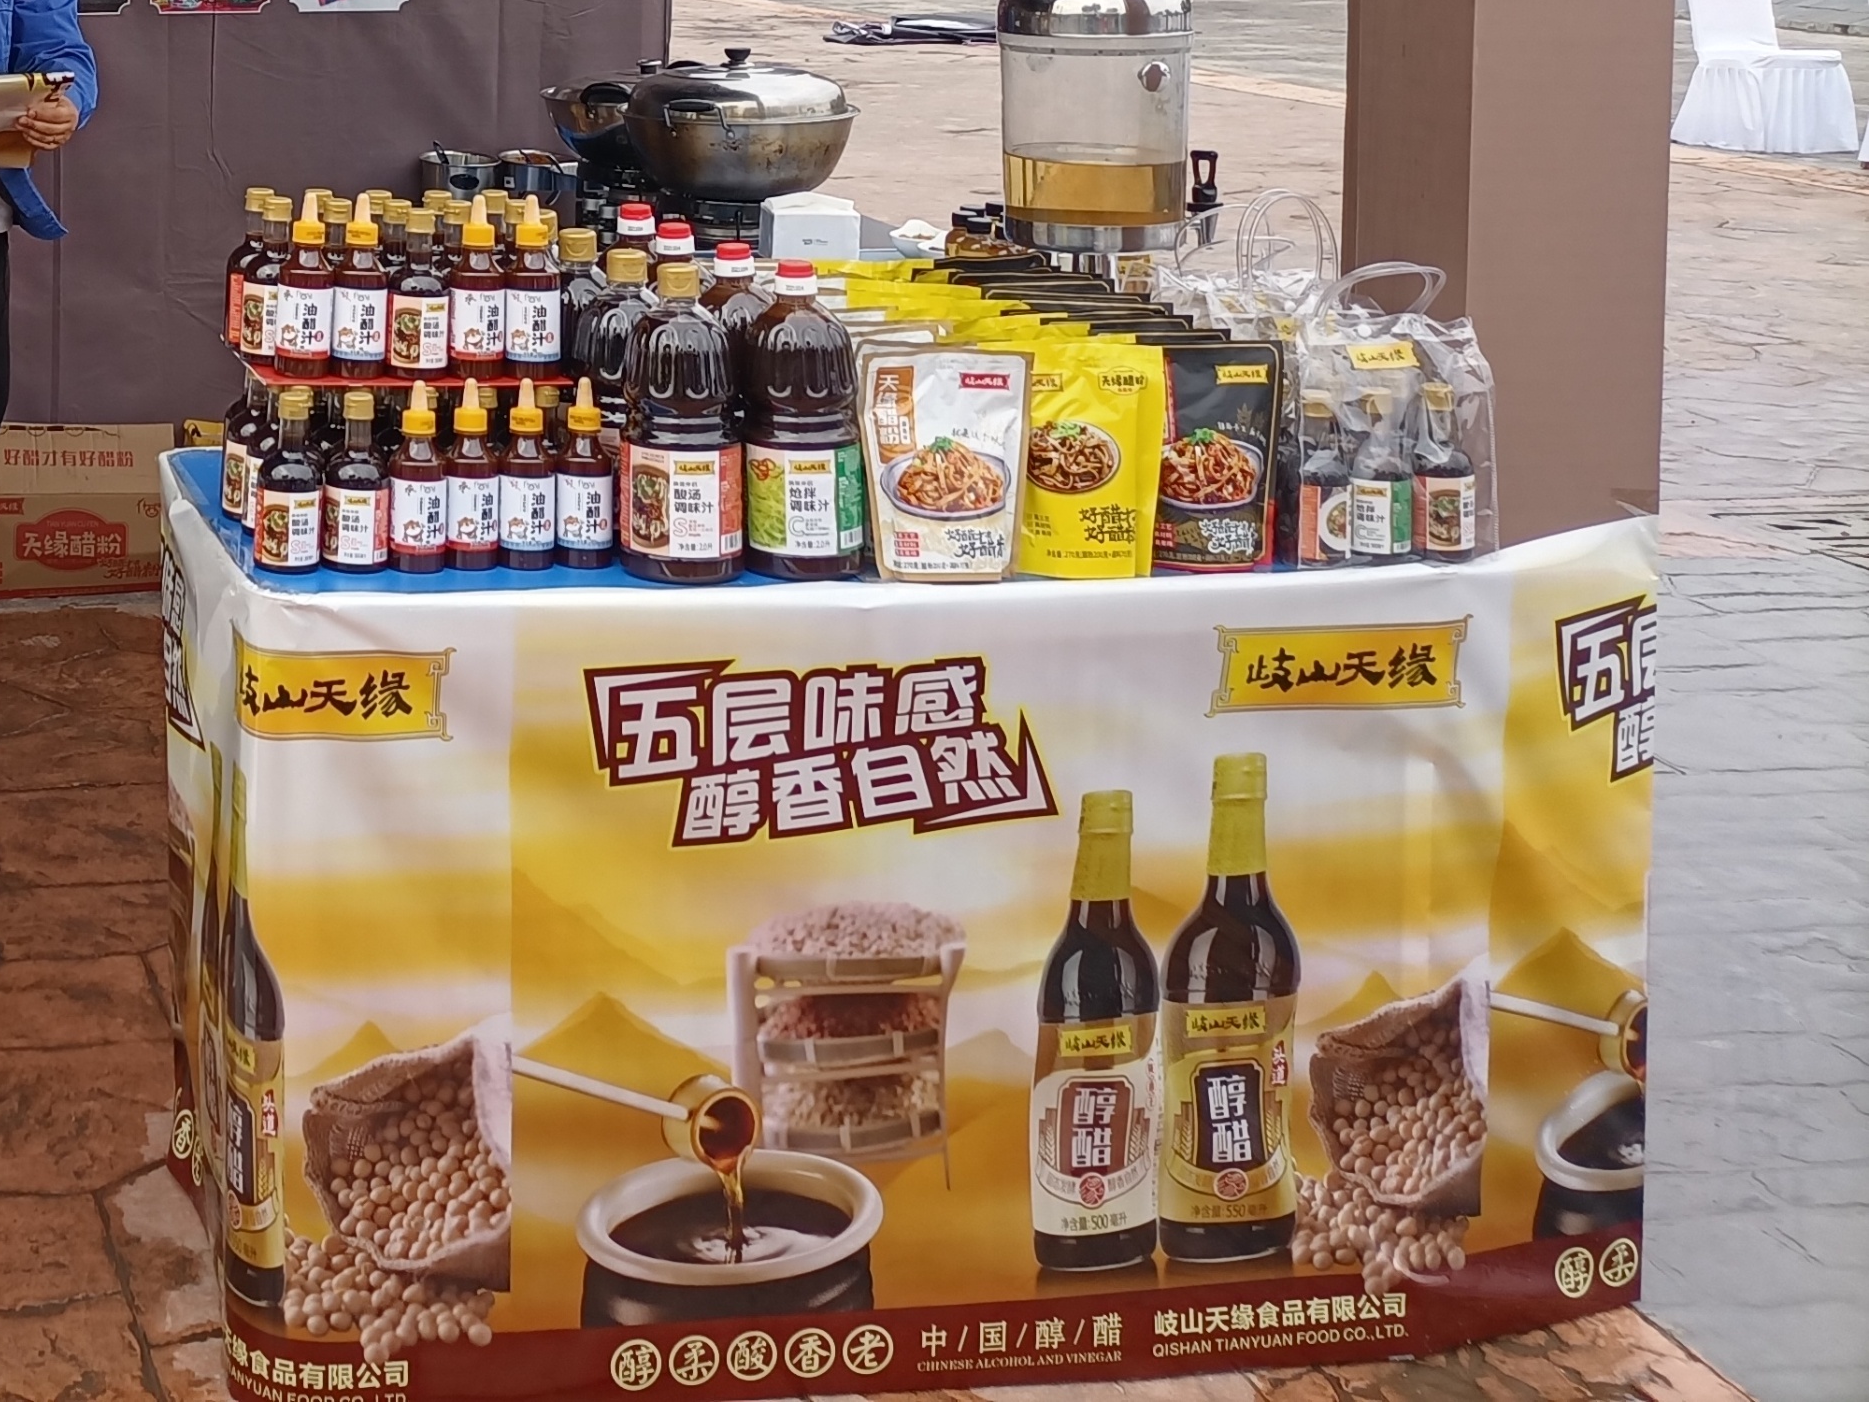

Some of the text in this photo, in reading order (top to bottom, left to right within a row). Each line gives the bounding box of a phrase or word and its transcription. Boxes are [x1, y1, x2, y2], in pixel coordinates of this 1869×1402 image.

[3, 449, 134, 468] 好醋才有好醋粉
[674, 501, 714, 514] 调味汁
[790, 500, 830, 513] 调味汁
[22, 531, 122, 558] 天缘醋粉
[1247, 644, 1437, 693] 岐山天缘
[616, 665, 978, 780] 五层味感
[681, 730, 1022, 840] 醇香自然
[1071, 1087, 1118, 1168] 醇醋
[1206, 1075, 1253, 1164] 醇醋
[1153, 1292, 1407, 1337] 岐山天缘食品有限公司
[917, 1350, 1123, 1372] CHINESE ALCOHOL AND VINEGAR
[1152, 1340, 1212, 1358] QISHAN
[1215, 1333, 1293, 1352] TIANYUAN
[1296, 1328, 1341, 1345] FOOD
